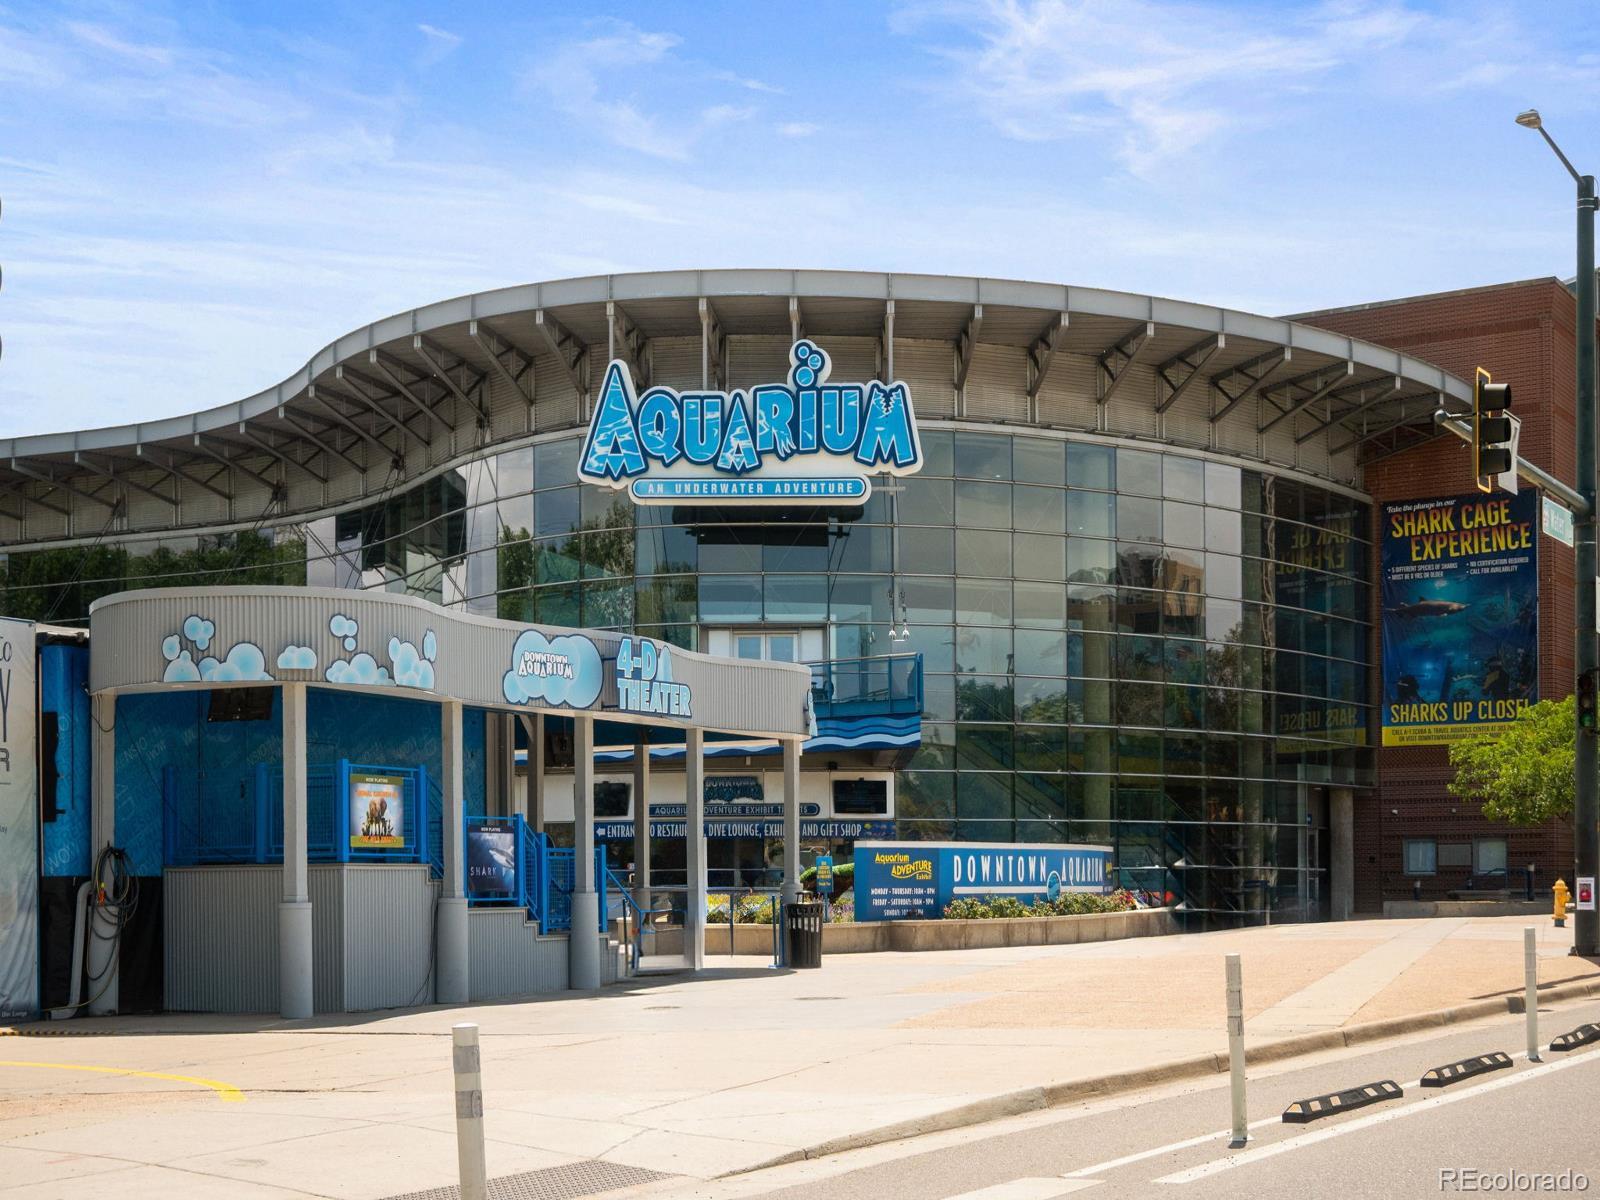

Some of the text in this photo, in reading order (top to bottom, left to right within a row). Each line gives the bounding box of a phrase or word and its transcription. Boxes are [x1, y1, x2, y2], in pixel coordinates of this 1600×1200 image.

[647, 482, 853, 494] AN UNDERWATER ADVENTURE
[1386, 505, 1402, 513] Take
[1402, 504, 1412, 512] the
[1413, 502, 1434, 512] plunge
[1391, 506, 1456, 538] SHARK
[1461, 499, 1512, 530] CAGE
[1410, 522, 1533, 562] EXPERIENCE
[524, 650, 569, 665] DOWNTOWN
[616, 637, 658, 682] 4-D
[518, 654, 574, 680] AQUARIUM
[616, 678, 692, 717] THEATER
[1391, 702, 1448, 723] SHARKS
[1453, 700, 1473, 721] UP
[703, 806, 742, 814] DVENTURE
[745, 806, 774, 814] EXHIBIT
[607, 824, 636, 838] ENTRAN
[650, 824, 656, 837] O
[708, 823, 727, 837] DIVE
[728, 823, 762, 839] LOUNGE,
[802, 823, 819, 837] AND
[820, 823, 839, 837] GIFT
[840, 823, 862, 837] SHOP
[875, 852, 910, 864] Aquarium
[470, 865, 497, 877] SHARK
[891, 860, 932, 876] ADVENTURE
[953, 855, 1047, 883] DOWNTOWN
[1061, 856, 1103, 886] AQUARIUM
[870, 887, 888, 895] MONDAY
[872, 898, 888, 906] FRIDAY
